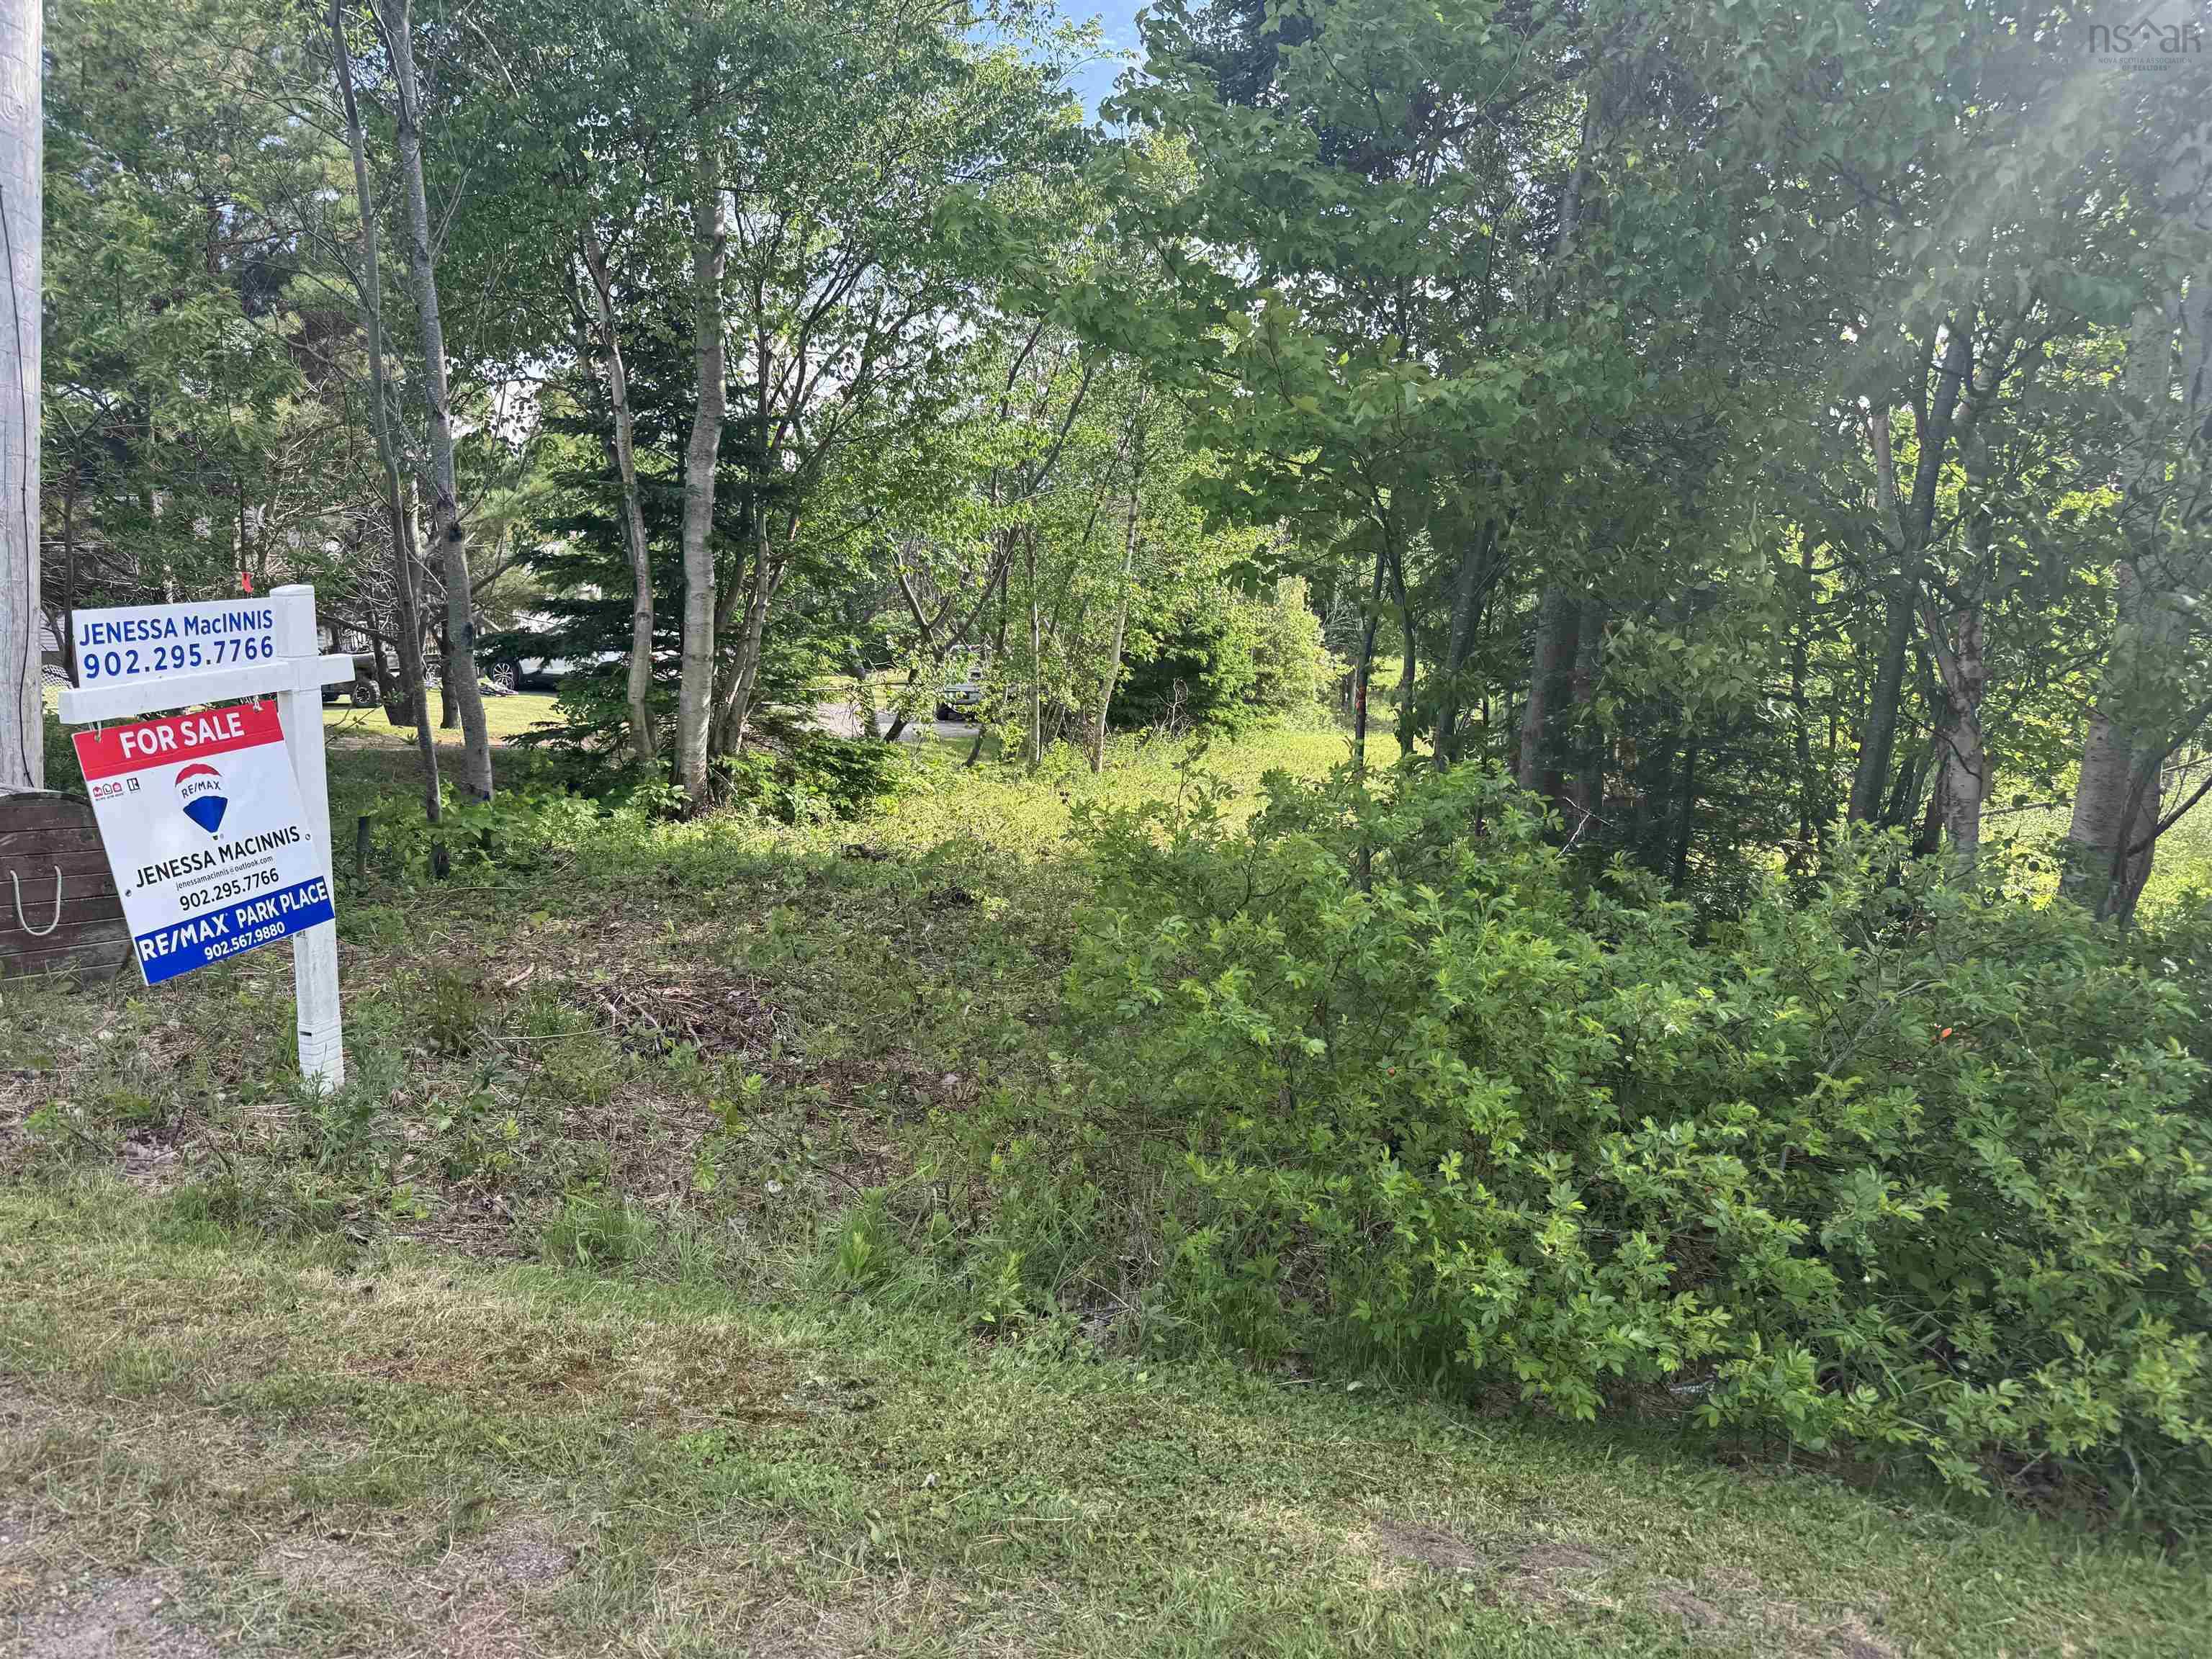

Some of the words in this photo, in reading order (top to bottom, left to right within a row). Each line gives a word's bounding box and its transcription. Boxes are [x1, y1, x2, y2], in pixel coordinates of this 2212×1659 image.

[80, 617, 177, 647] JENESSA
[184, 609, 274, 637] MacINNIS
[84, 636, 274, 679] 902.295.7766
[120, 725, 179, 759] FOR
[184, 712, 246, 746] SALE
[181, 781, 221, 799] RE/MAX
[135, 850, 216, 888] JENESSA
[218, 826, 301, 863] MACINNIS
[179, 868, 279, 911] 902.295.7766
[139, 913, 230, 961] RE/MAX
[235, 899, 282, 929] PARK
[282, 880, 328, 920] PLACE
[204, 921, 286, 961] 902.567.9880
